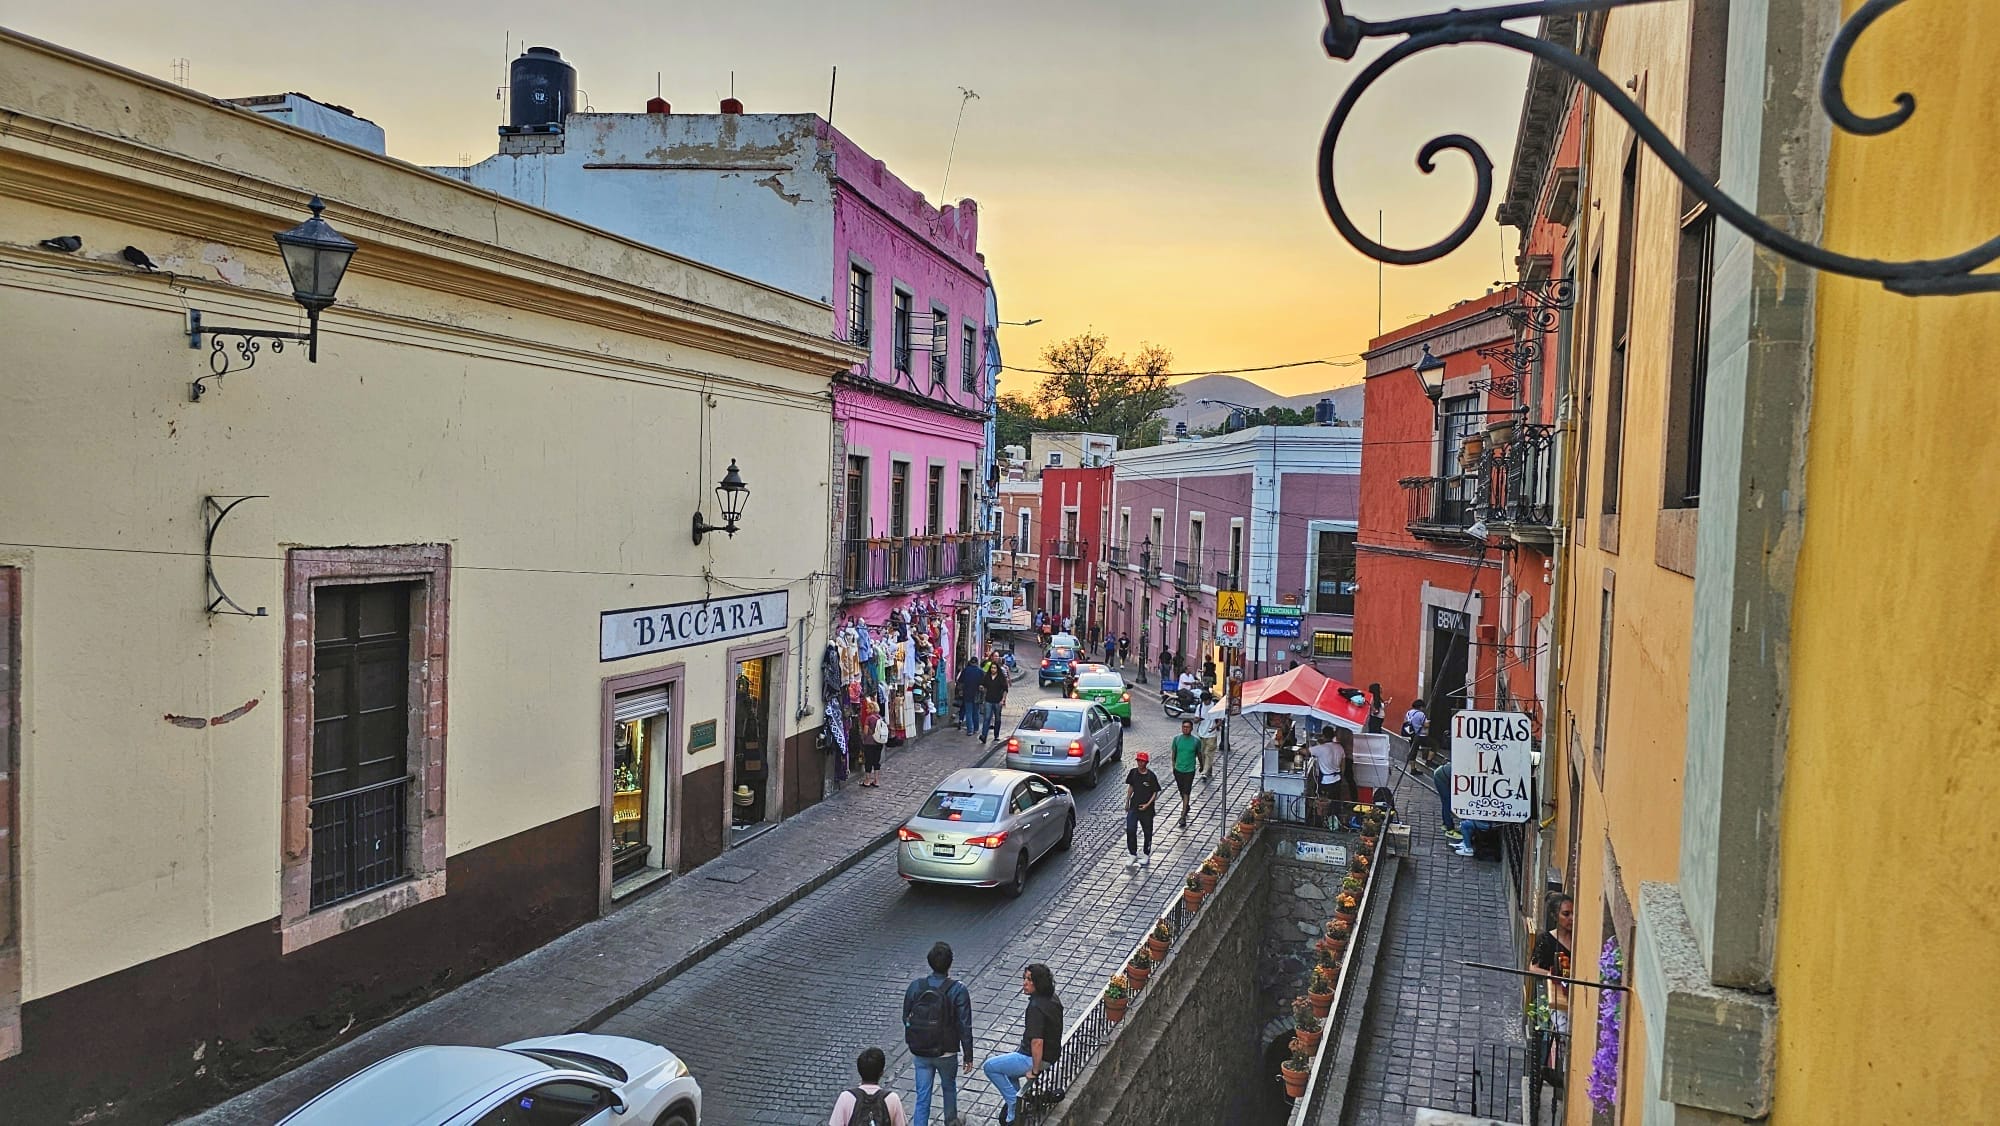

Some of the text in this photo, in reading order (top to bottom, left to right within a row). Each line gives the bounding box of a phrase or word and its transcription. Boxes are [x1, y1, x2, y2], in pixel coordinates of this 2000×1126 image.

[633, 600, 764, 646] BACCARA
[1437, 610, 1464, 630] BBVA
[1455, 715, 1529, 743] TORTAS
[1478, 751, 1504, 775] LA
[1454, 774, 1528, 800] PULGA
